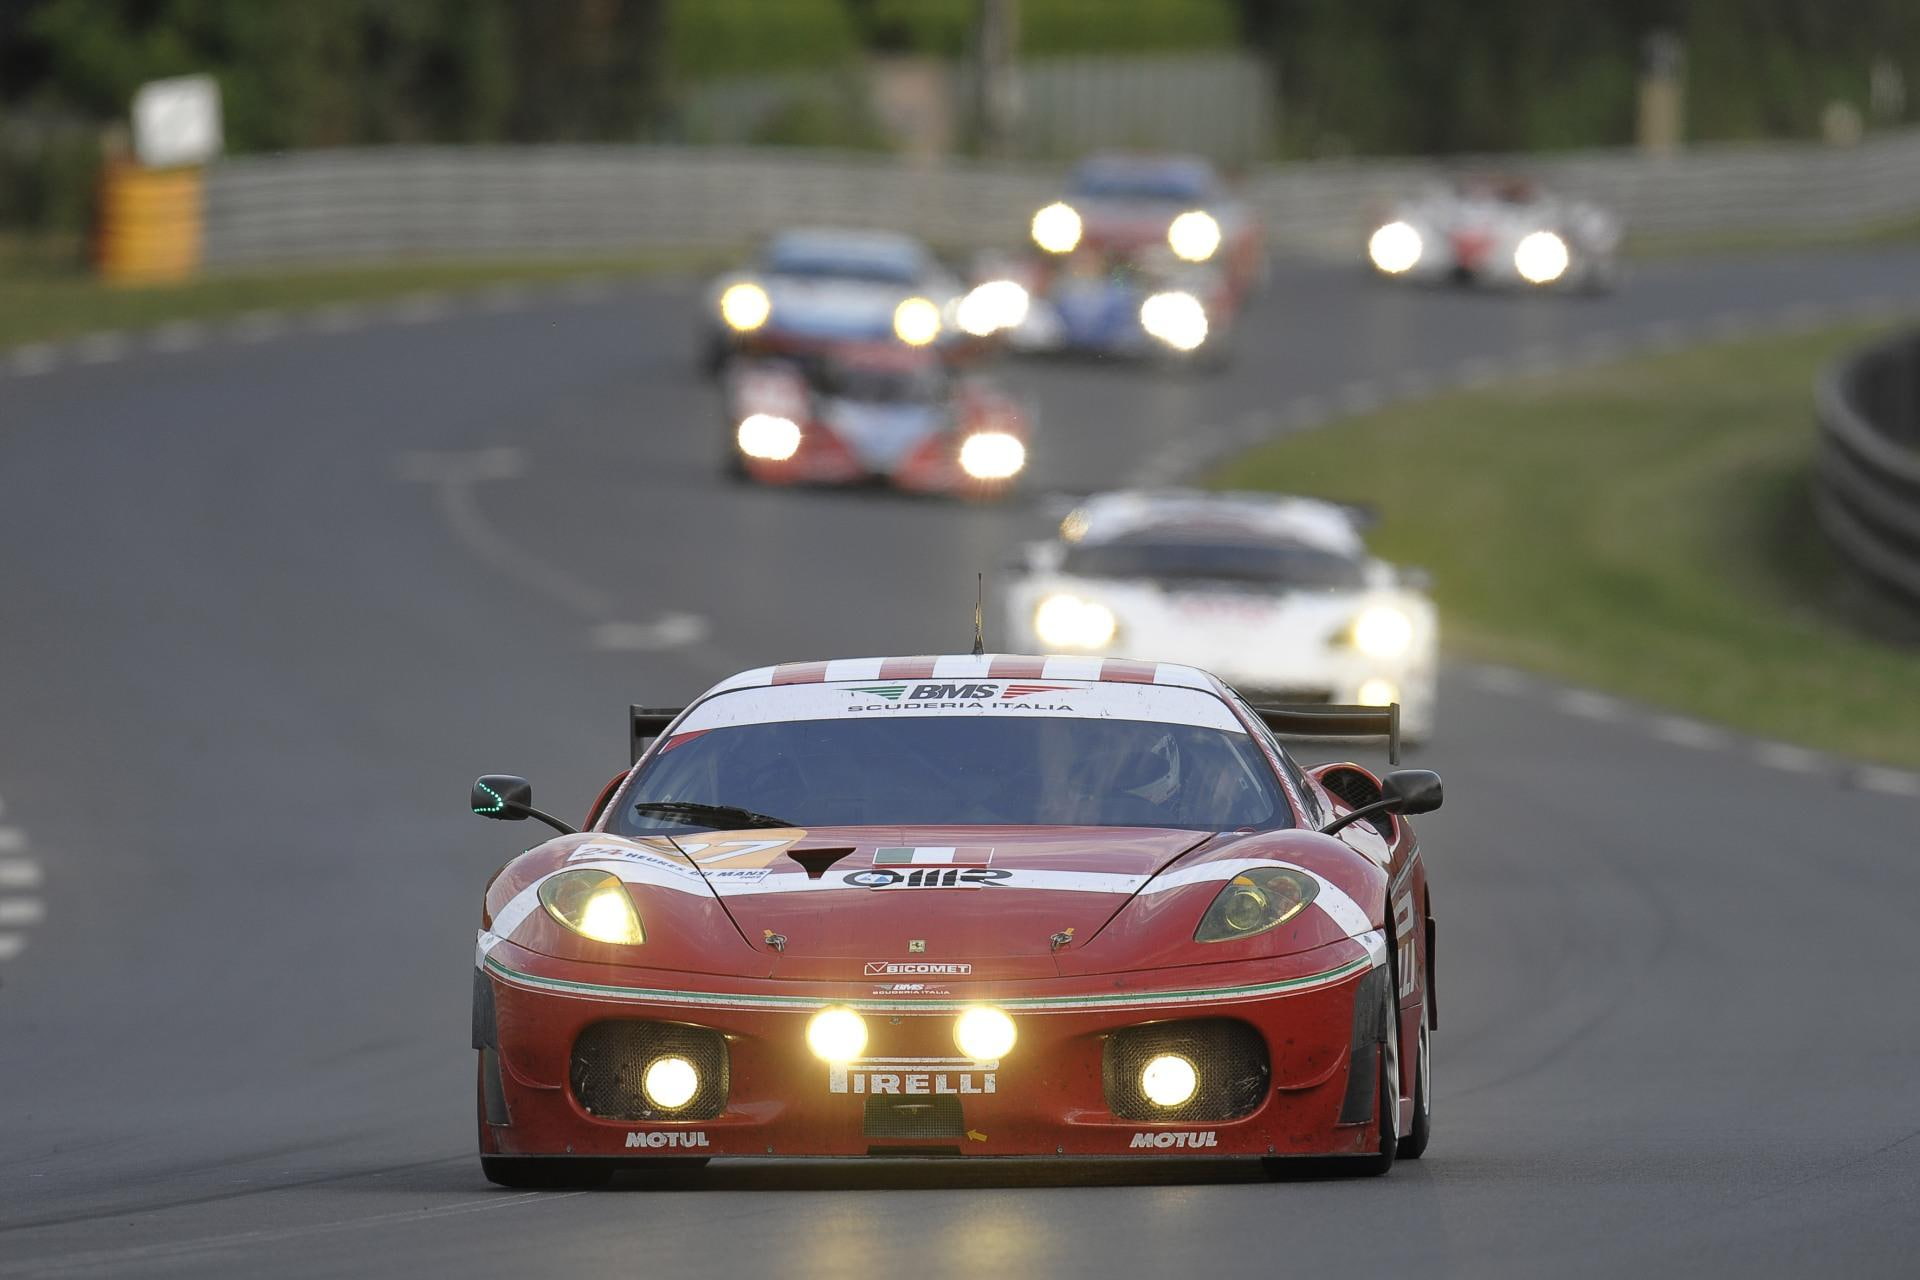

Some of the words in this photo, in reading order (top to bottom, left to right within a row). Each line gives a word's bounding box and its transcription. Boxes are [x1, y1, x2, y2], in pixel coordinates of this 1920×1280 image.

[908, 684, 999, 699] BMS
[848, 702, 984, 712] SCUDERIA
[992, 702, 1074, 711] ITALIA
[576, 847, 622, 859] 24
[625, 852, 685, 872] HEURES
[689, 870, 713, 878] DU
[719, 870, 769, 878] MANS
[886, 965, 969, 973] BICOMET
[829, 1056, 1000, 1094] PIRELLI
[625, 1131, 710, 1148] MOTUL
[1129, 1131, 1218, 1148] MOTUL
